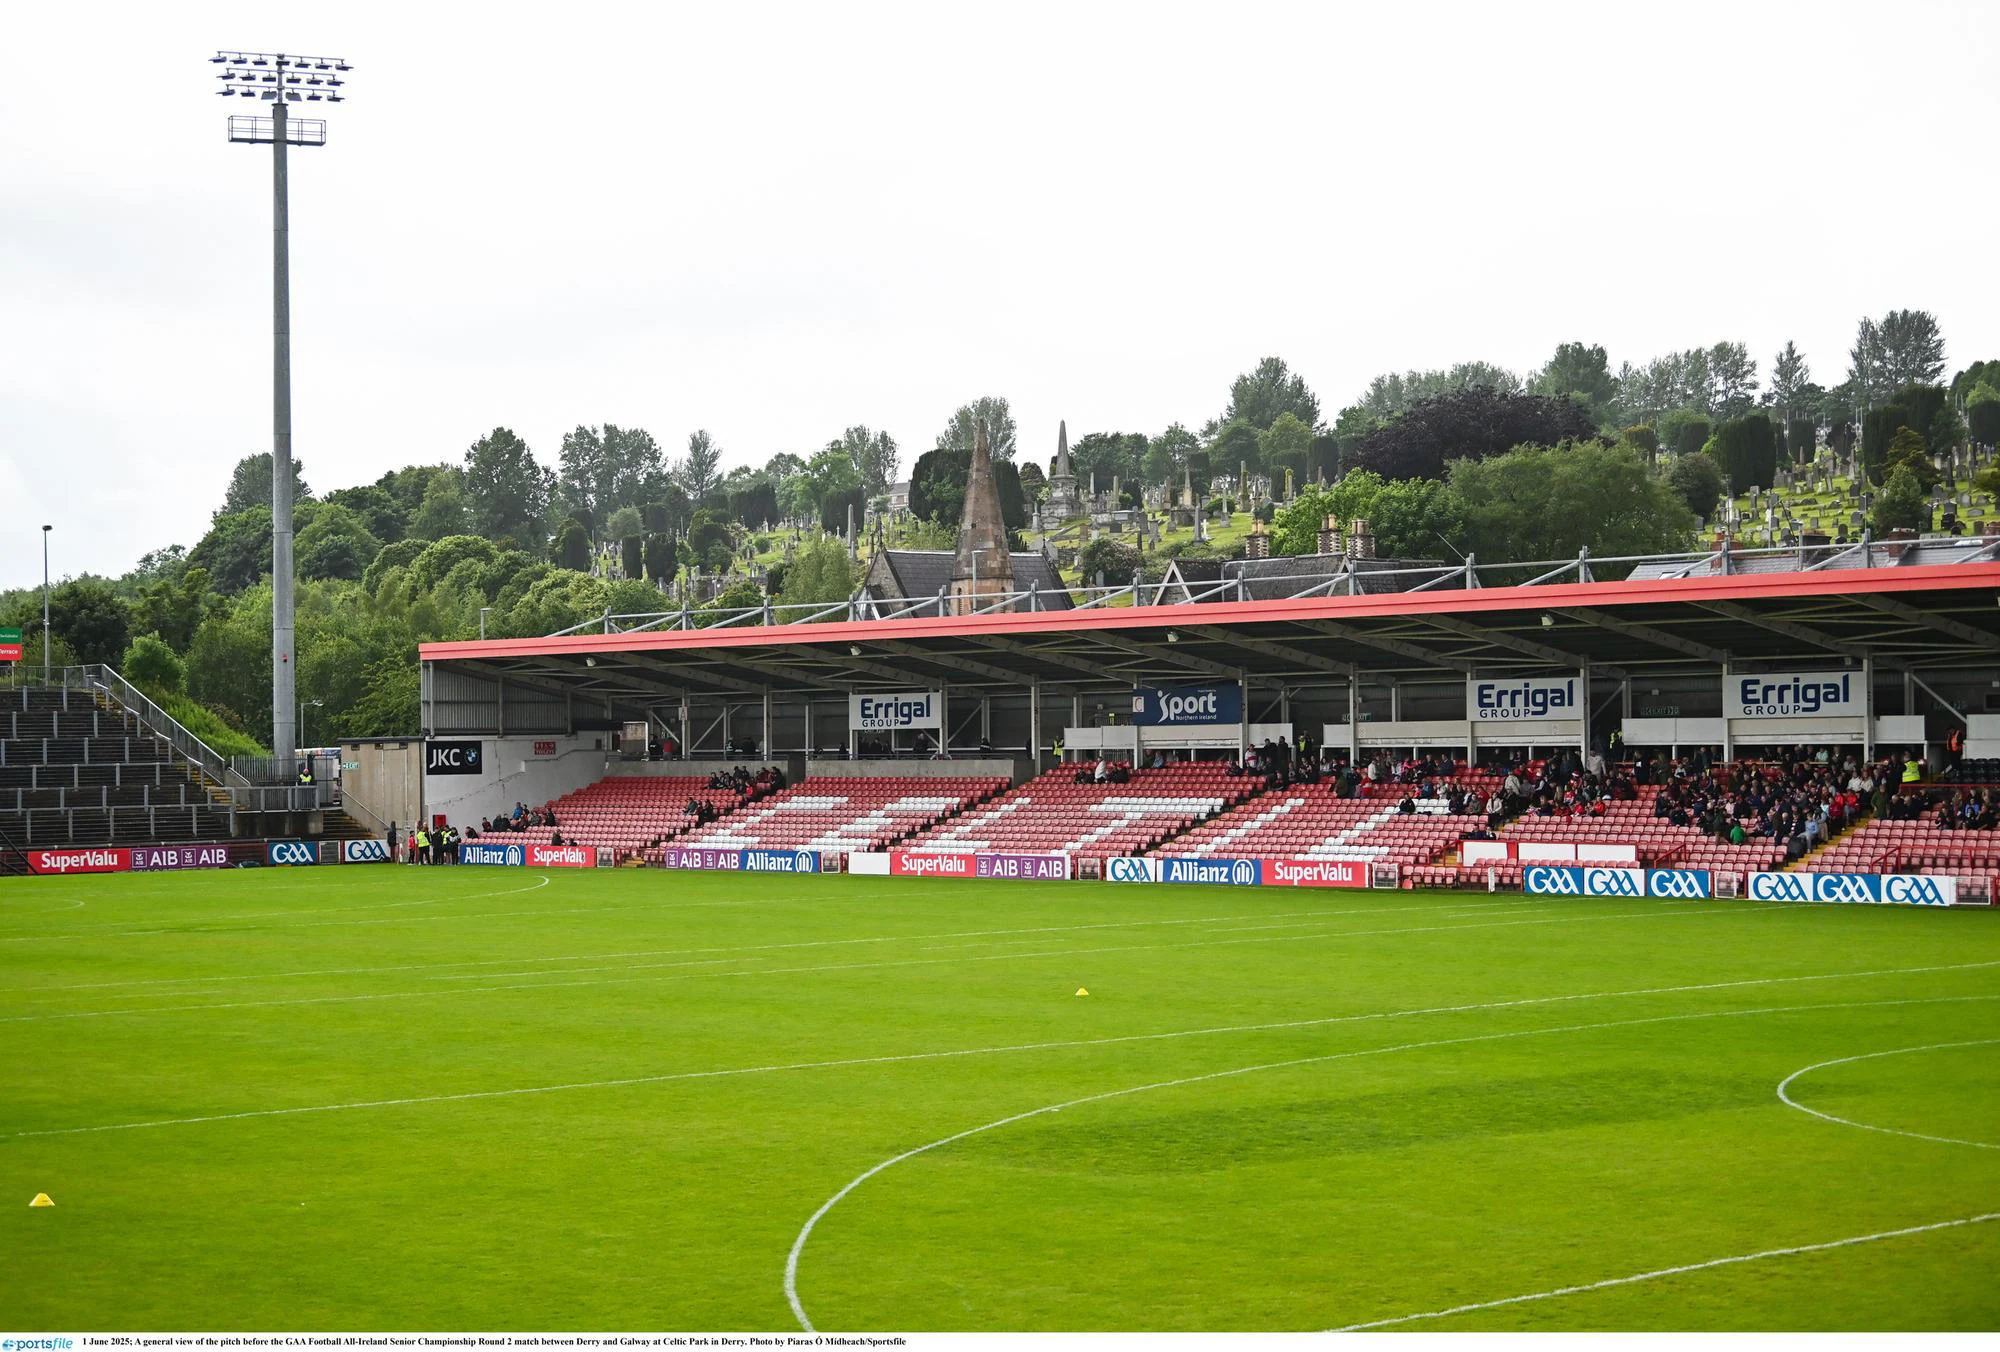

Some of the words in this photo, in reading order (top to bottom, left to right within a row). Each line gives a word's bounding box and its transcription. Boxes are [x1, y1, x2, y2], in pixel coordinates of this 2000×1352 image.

[1477, 679, 1574, 716] Errigal
[1741, 673, 1850, 713] Errigal
[860, 693, 931, 726] Errigal
[1157, 689, 1217, 723] Sport
[1479, 709, 1530, 718] GROUP
[1743, 705, 1800, 716] GROUP
[861, 718, 900, 727] GROUP
[429, 748, 461, 769] JKC
[41, 851, 118, 872] SuperValu
[150, 851, 178, 866] AIB
[199, 849, 227, 864] AIB
[272, 843, 314, 863] GAA
[464, 847, 504, 864] Allianz
[533, 847, 586, 866] SuperValu
[680, 851, 701, 867] AIB
[717, 853, 739, 869] AIB
[746, 852, 793, 870] Allianz
[901, 855, 966, 876] SuperValu
[992, 859, 1018, 876] AIB
[1037, 860, 1063, 878] AIB
[1111, 858, 1151, 881] GAA
[1169, 861, 1229, 882] Allianz
[1274, 861, 1353, 886] SuperValu
[1528, 867, 1579, 894] GAA
[1588, 869, 1640, 896] GAA
[1650, 871, 1705, 898] GAA
[1752, 873, 1809, 900] GAA
[1816, 875, 1875, 902] GAA
[1885, 876, 1945, 904] GAA
